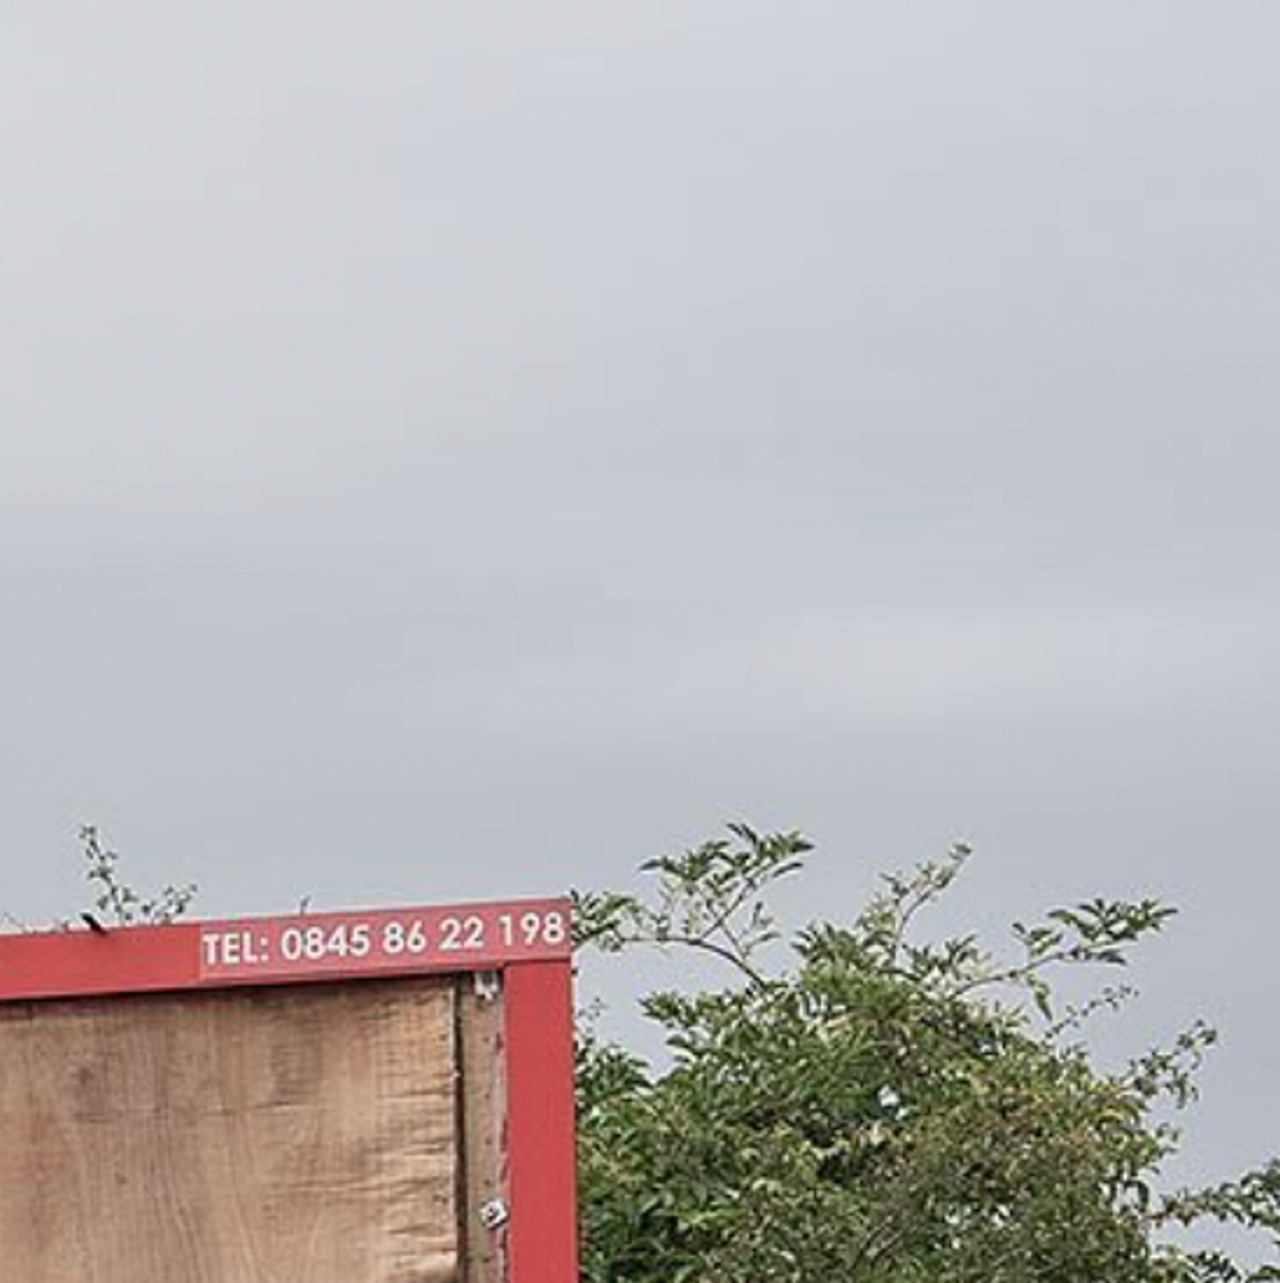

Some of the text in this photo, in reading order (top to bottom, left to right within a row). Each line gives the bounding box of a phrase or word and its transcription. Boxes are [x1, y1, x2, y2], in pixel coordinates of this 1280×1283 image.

[203, 911, 565, 965] TEL: 0845 86 22 198
